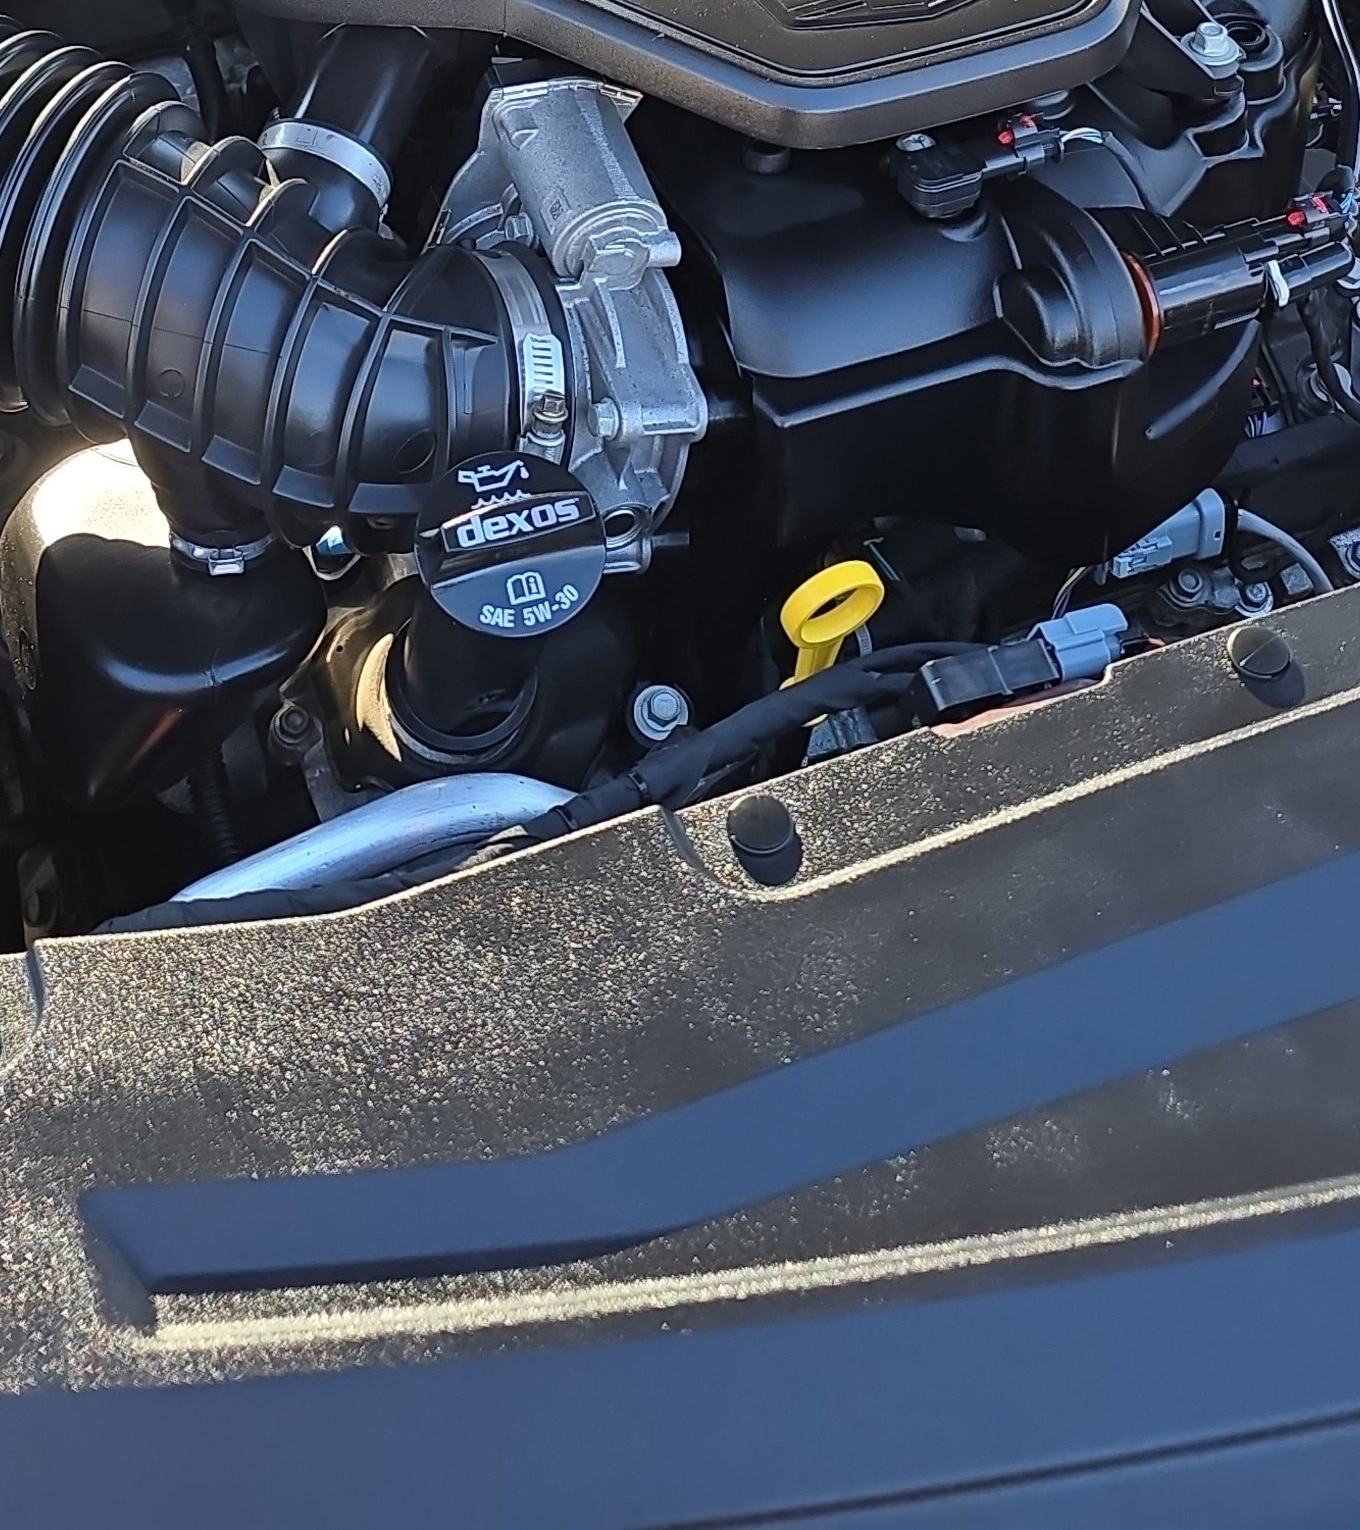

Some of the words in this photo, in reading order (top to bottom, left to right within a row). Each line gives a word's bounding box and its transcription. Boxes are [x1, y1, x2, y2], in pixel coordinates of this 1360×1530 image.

[456, 498, 579, 549] dexos
[479, 605, 515, 628] SAE
[523, 584, 579, 627] 5W-30
